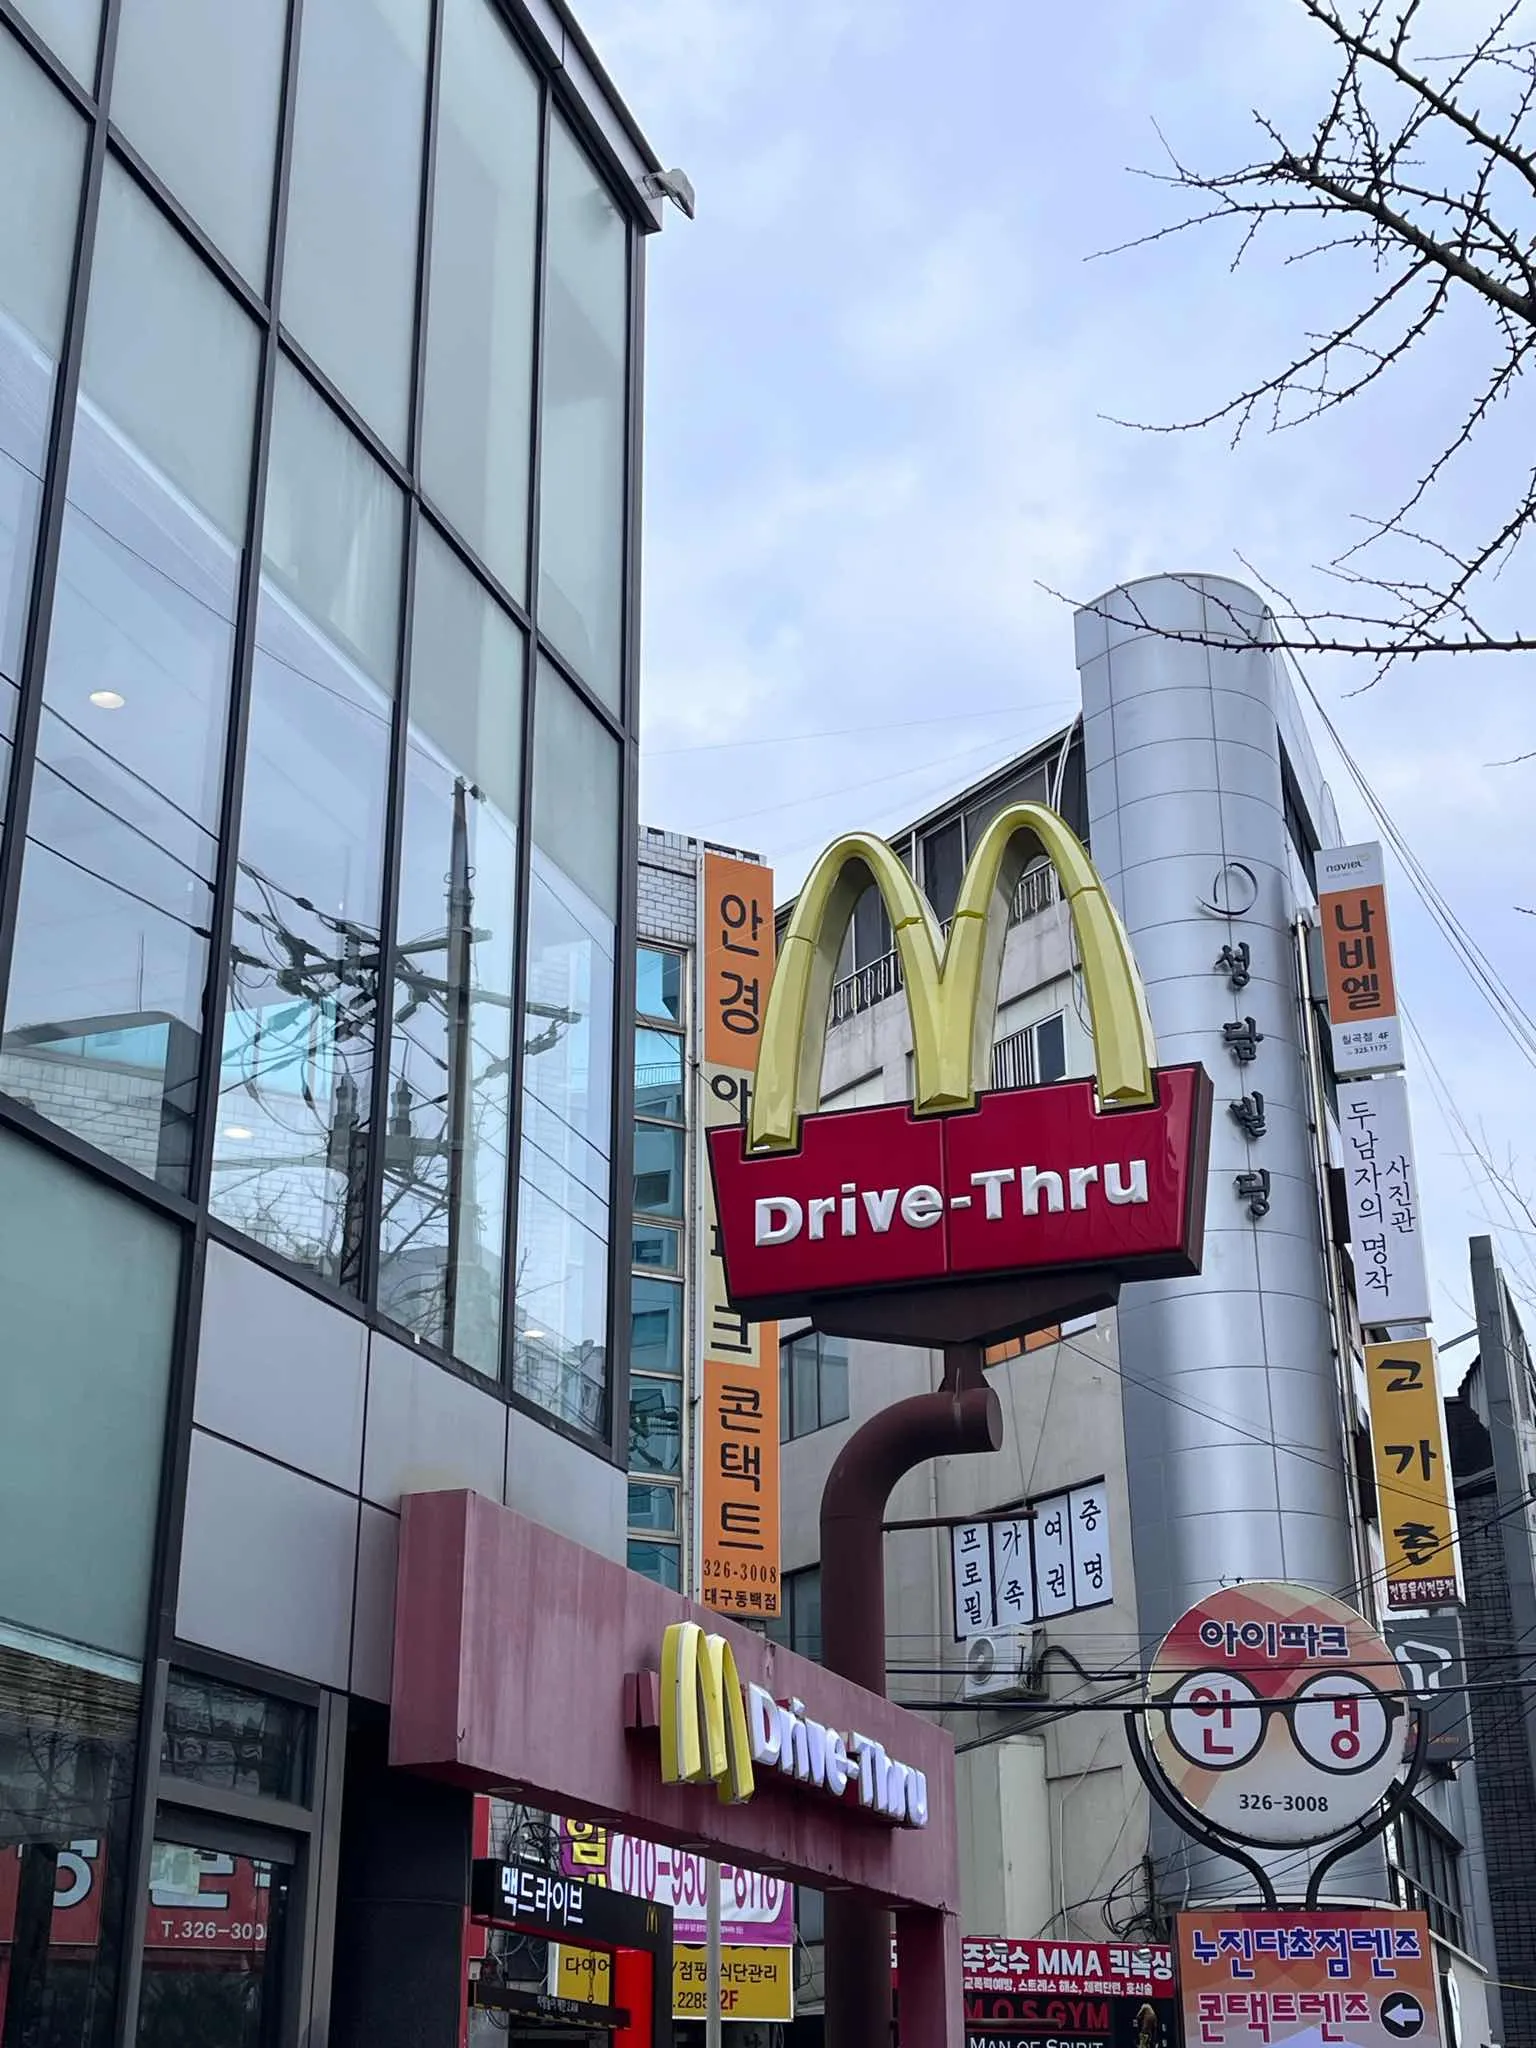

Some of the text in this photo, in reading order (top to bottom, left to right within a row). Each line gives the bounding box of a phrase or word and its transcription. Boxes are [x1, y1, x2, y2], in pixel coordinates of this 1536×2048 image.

[720, 894, 763, 1036] 안경
[1335, 899, 1381, 1011] 나비엘
[754, 1159, 1149, 1247] Drive-Thru
[1347, 1101, 1393, 1297] 두남자의 명작
[1386, 1155, 1417, 1234] 사진관
[718, 1384, 764, 1551] 콘택트
[703, 1559, 777, 1584] 326-3008
[960, 1528, 982, 1625] 프로필
[1002, 1522, 1025, 1611] 가족
[1044, 1511, 1066, 1598] 여권
[704, 1587, 777, 1610] 대구동백점
[1200, 1620, 1351, 1658] 아이파크
[749, 1681, 929, 1829] Drive-Thru
[1239, 1794, 1329, 1812] 326-3008
[161, 1920, 267, 1940] T.326-300
[502, 1866, 584, 1927] 맥드라이브
[1037, 1947, 1103, 1976] MMA
[1193, 1928, 1421, 1979] 누진다초점렌즈
[1199, 1993, 1370, 2043] 콘택트렌즈
